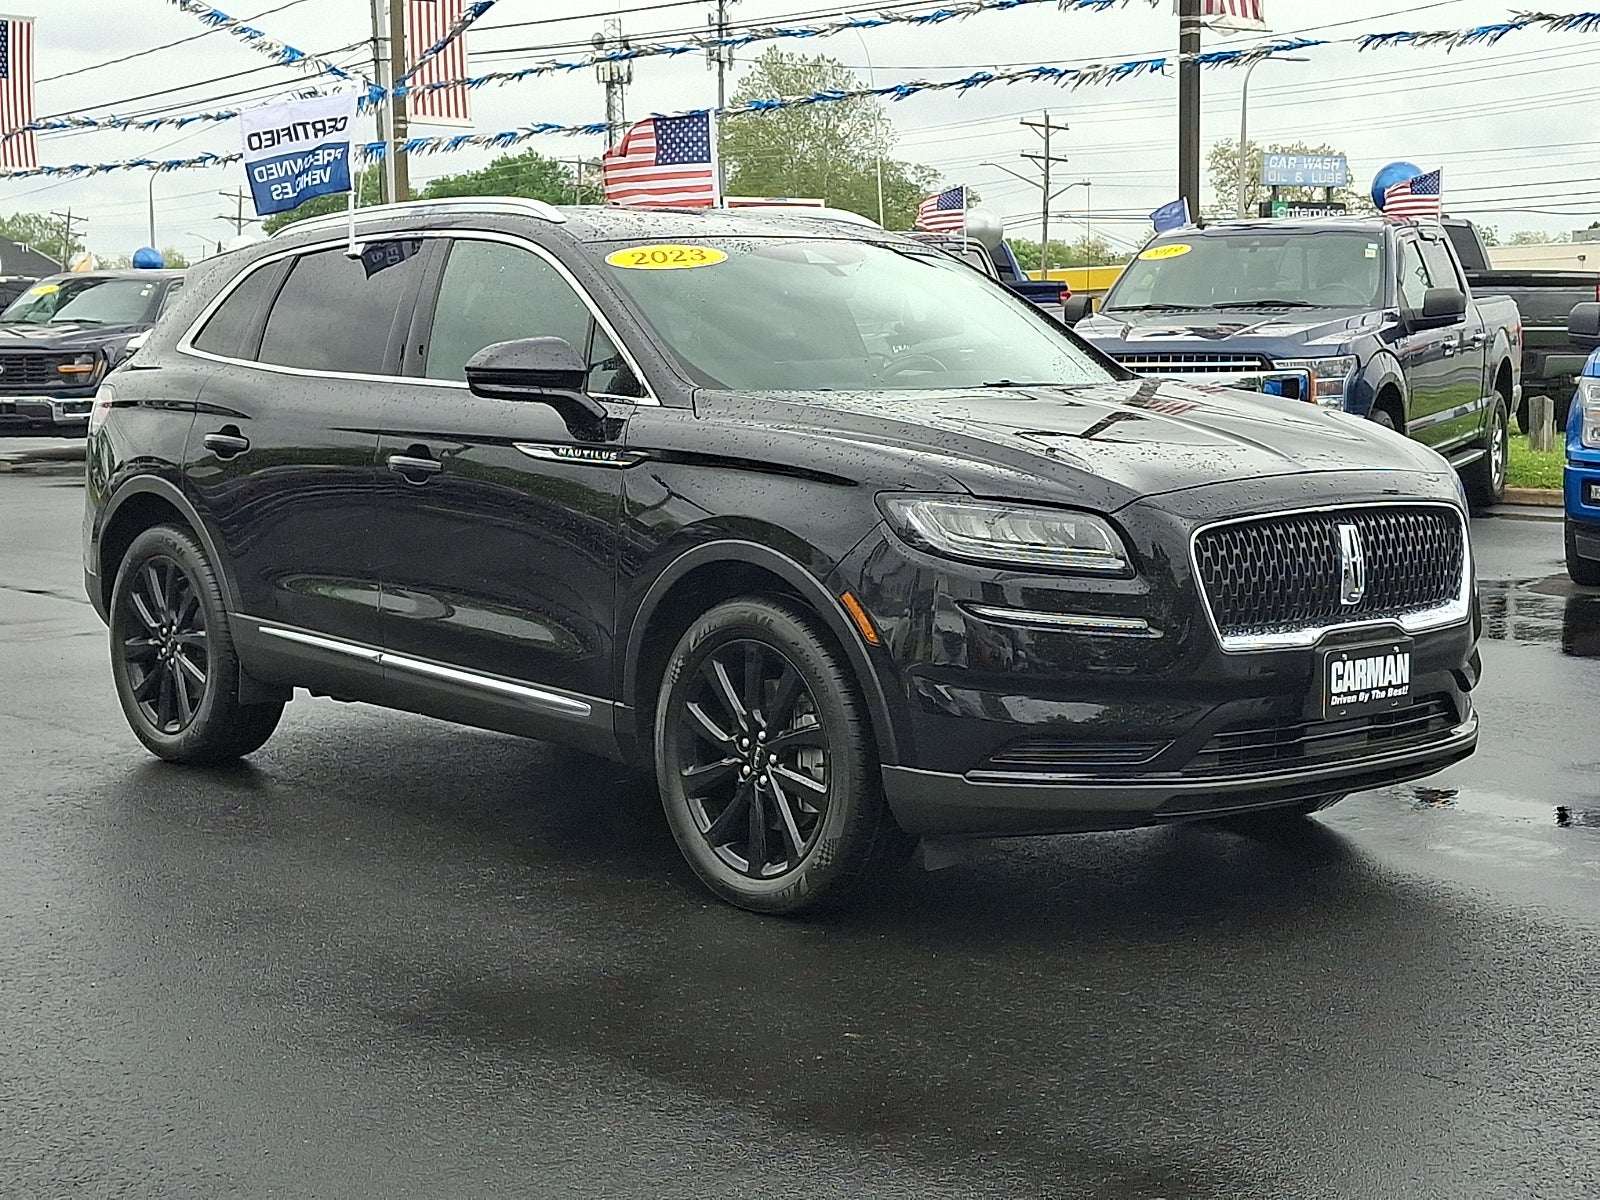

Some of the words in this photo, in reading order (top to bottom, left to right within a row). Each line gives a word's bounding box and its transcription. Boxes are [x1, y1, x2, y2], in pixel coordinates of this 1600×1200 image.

[1269, 156, 1297, 169] CAR
[1303, 157, 1341, 170] WASH
[1267, 170, 1287, 182] OIL
[1295, 171, 1304, 183] &
[1311, 172, 1343, 184] LUBE
[631, 248, 707, 265] 2023
[558, 447, 617, 460] NAUTILUS
[1331, 652, 1410, 694] CARMAN
[1330, 695, 1357, 706] Driven
[1358, 691, 1370, 703] By
[1371, 689, 1386, 700] The
